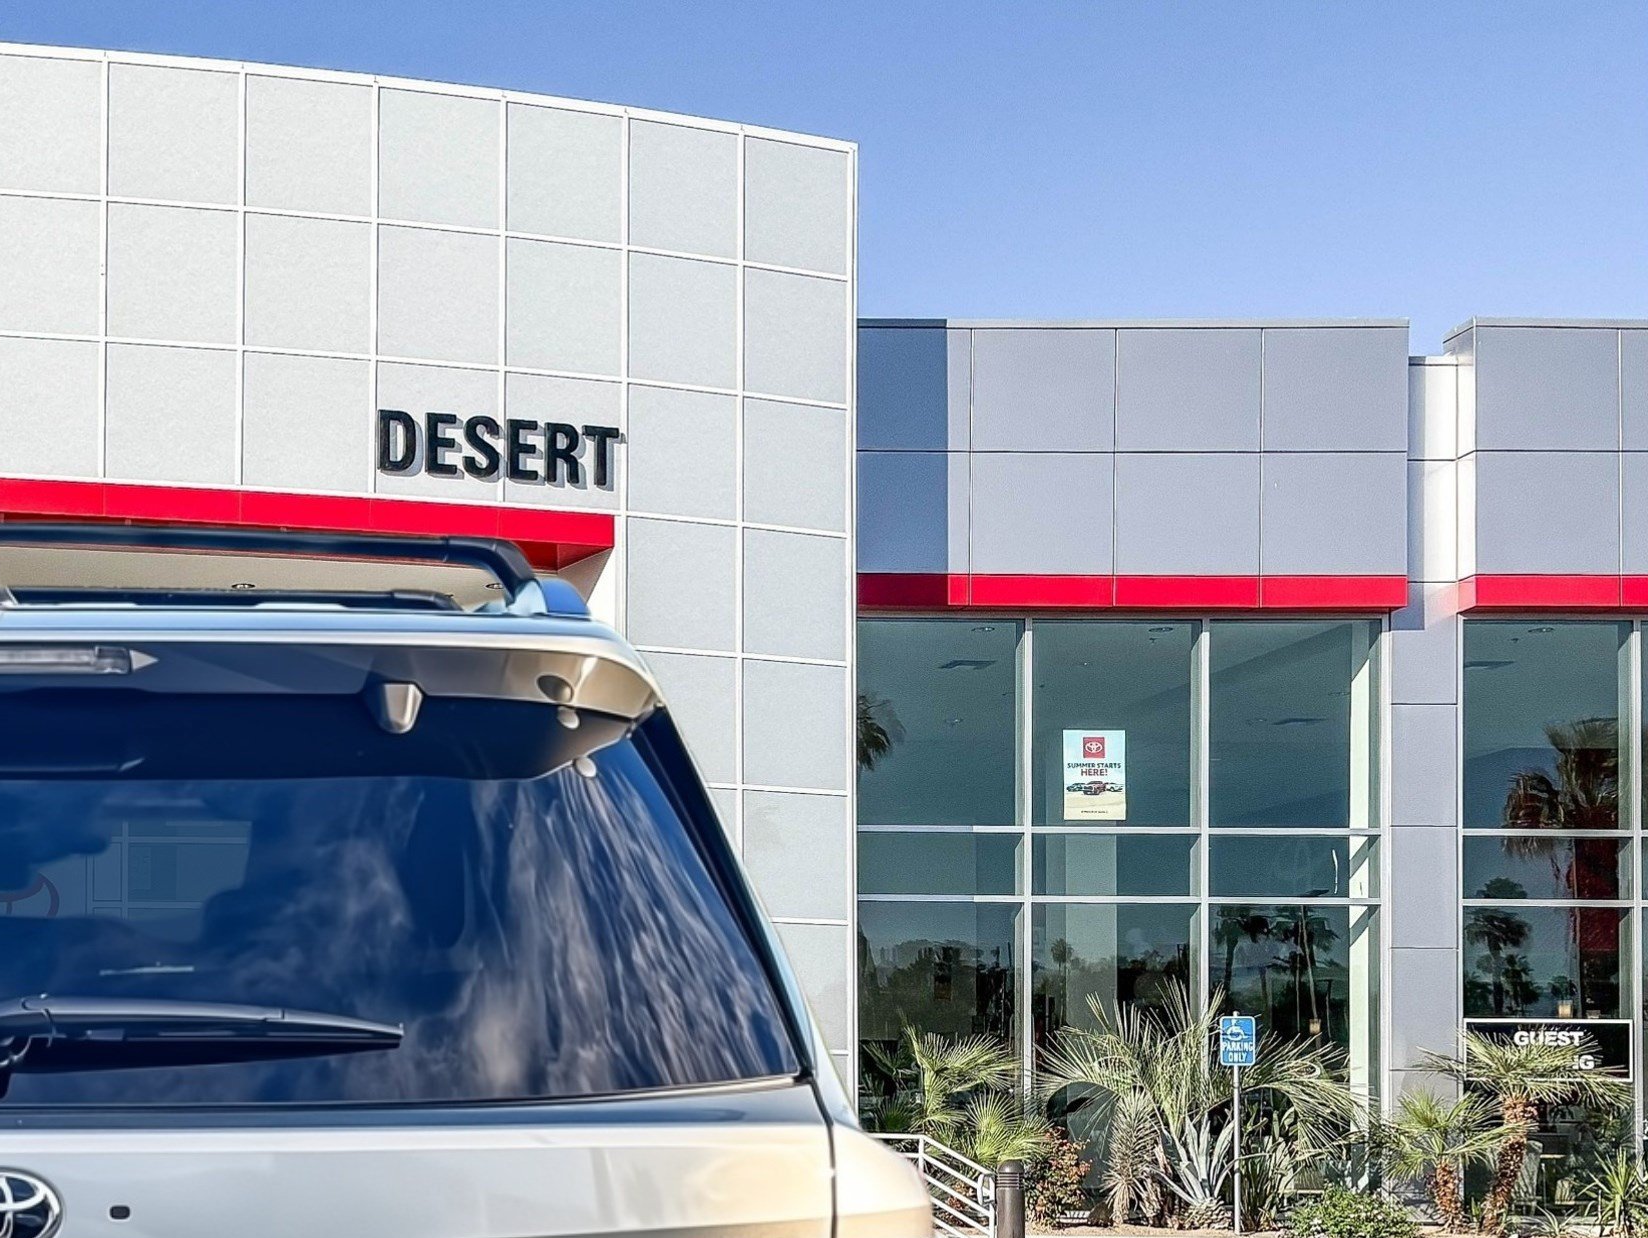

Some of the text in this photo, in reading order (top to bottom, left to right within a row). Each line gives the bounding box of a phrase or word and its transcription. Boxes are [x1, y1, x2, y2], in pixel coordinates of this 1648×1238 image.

[377, 409, 620, 487] DESERT
[1080, 768, 1108, 776] HERE!
[1513, 1030, 1584, 1047] GUEST
[1222, 1041, 1254, 1052] PARKING
[1228, 1052, 1247, 1062] ONLY
